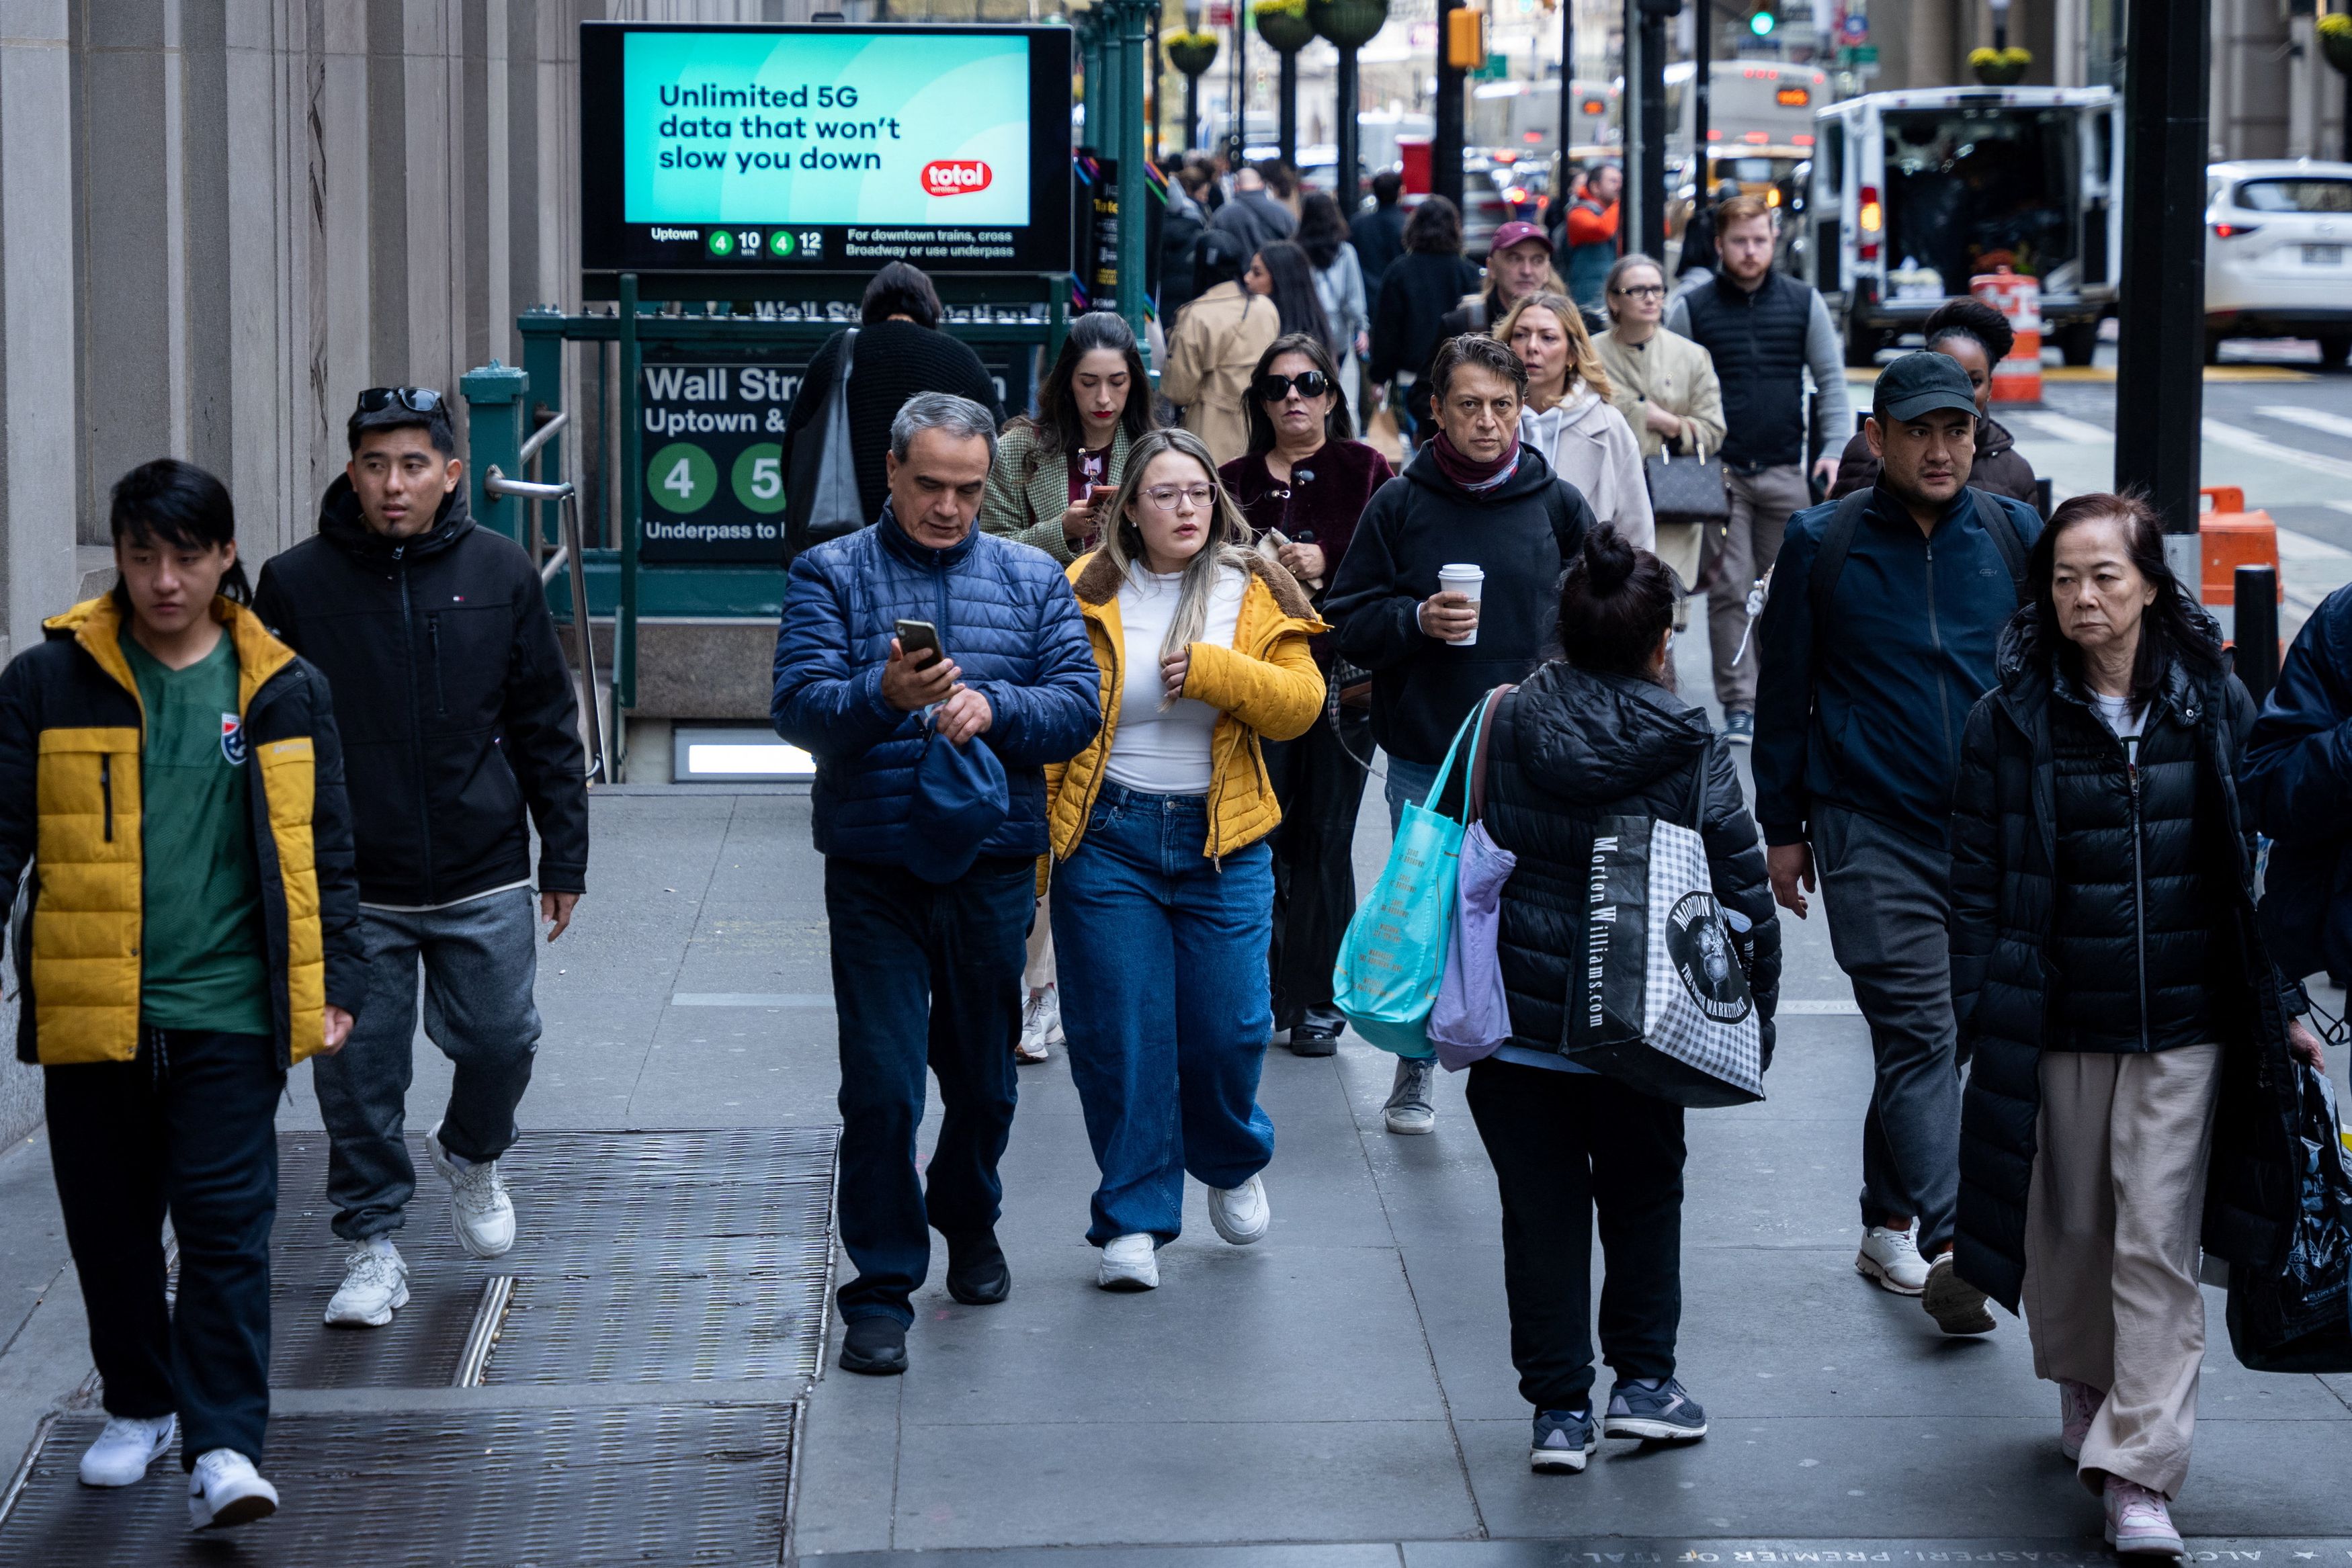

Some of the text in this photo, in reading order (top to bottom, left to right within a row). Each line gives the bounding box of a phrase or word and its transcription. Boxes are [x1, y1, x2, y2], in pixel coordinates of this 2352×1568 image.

[659, 83, 858, 107] Unlimited 5G
[659, 114, 732, 138] data
[739, 115, 806, 138] that
[659, 144, 880, 174] slow you down
[929, 163, 983, 186] total
[650, 227, 822, 251] Uptown 4 10 4 12
[847, 228, 1013, 243] For downtown trains, cross
[802, 249, 817, 257] MIN
[846, 244, 1015, 259] Broadway or use underpass
[645, 367, 727, 400] Wall
[645, 408, 786, 437] Uptown &
[664, 458, 781, 499] 4 5
[646, 521, 752, 542] Underpass
[755, 522, 777, 538] to
[1672, 896, 1710, 932] MORTON
[1681, 963, 1693, 986] THE
[1559, 1553, 1662, 1563] ITALY
[1676, 1552, 1720, 1563] OF
[1732, 1551, 1890, 1562] PREMIER
[1903, 1551, 2069, 1561] GASPERI,
[2173, 1551, 2261, 1561] ALCI
